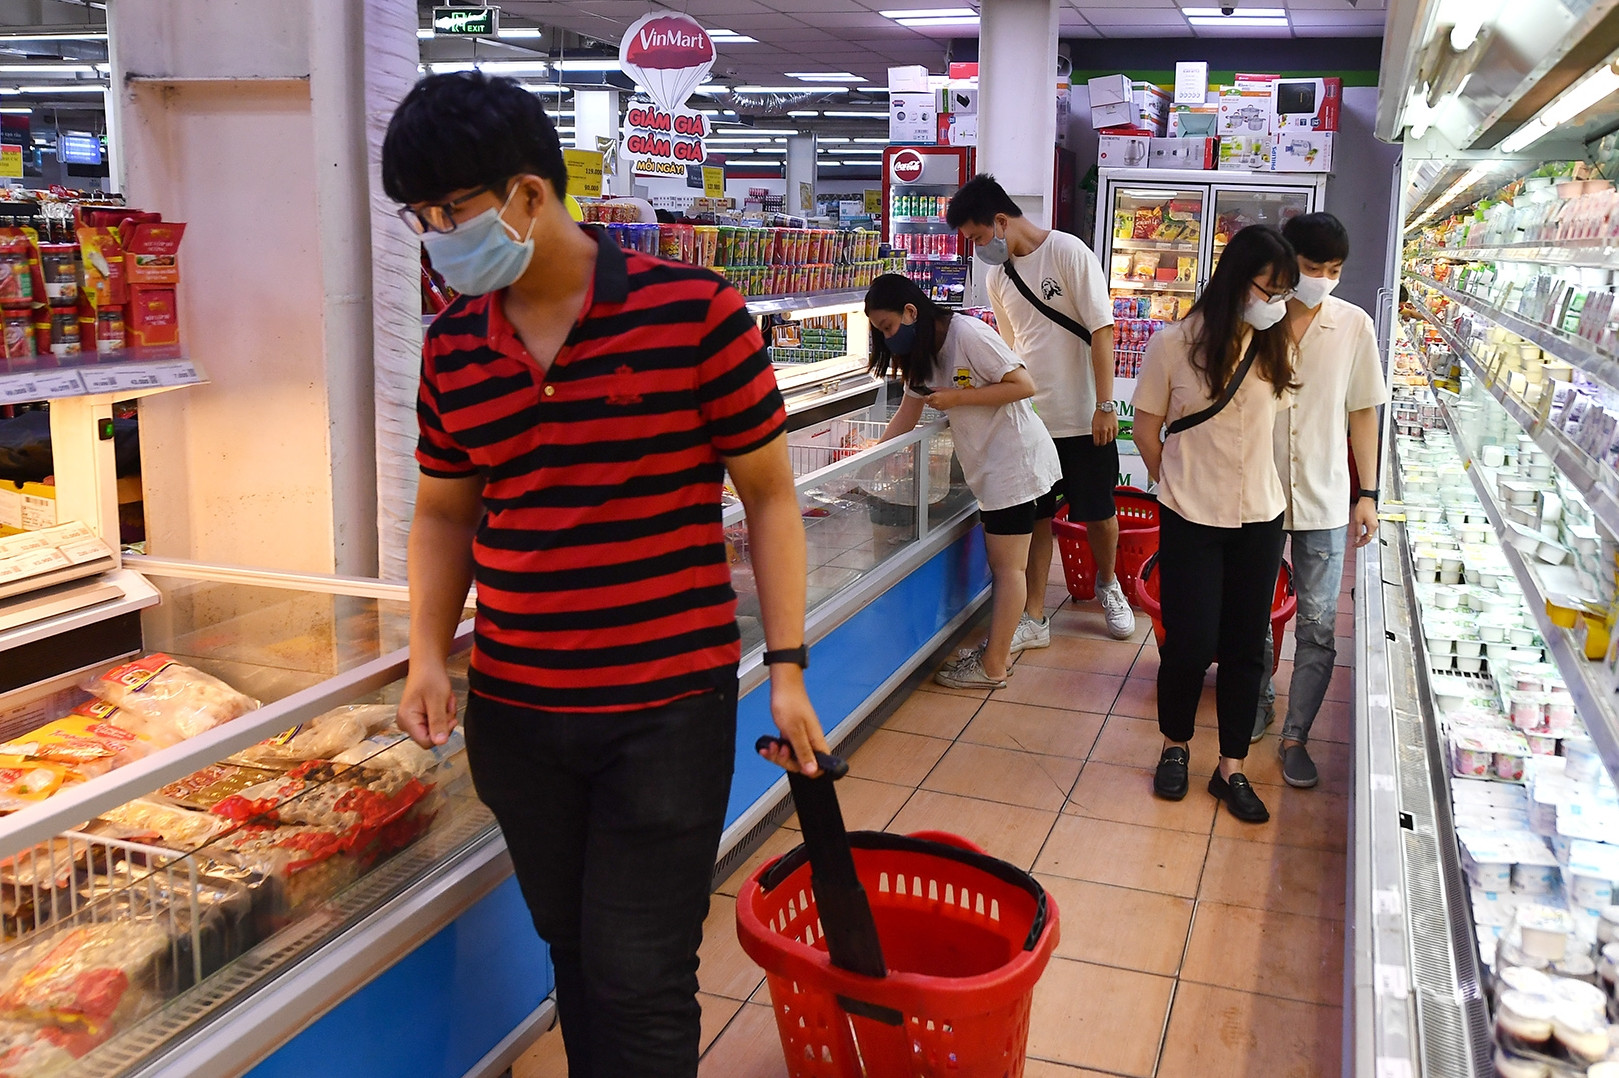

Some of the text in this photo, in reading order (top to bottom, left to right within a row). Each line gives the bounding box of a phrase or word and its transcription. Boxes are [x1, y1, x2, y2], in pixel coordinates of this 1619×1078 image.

[640, 28, 704, 51] VinMart
[629, 106, 705, 137] GIẢM GIÁ
[627, 133, 704, 162] GIẢM GIÁ
